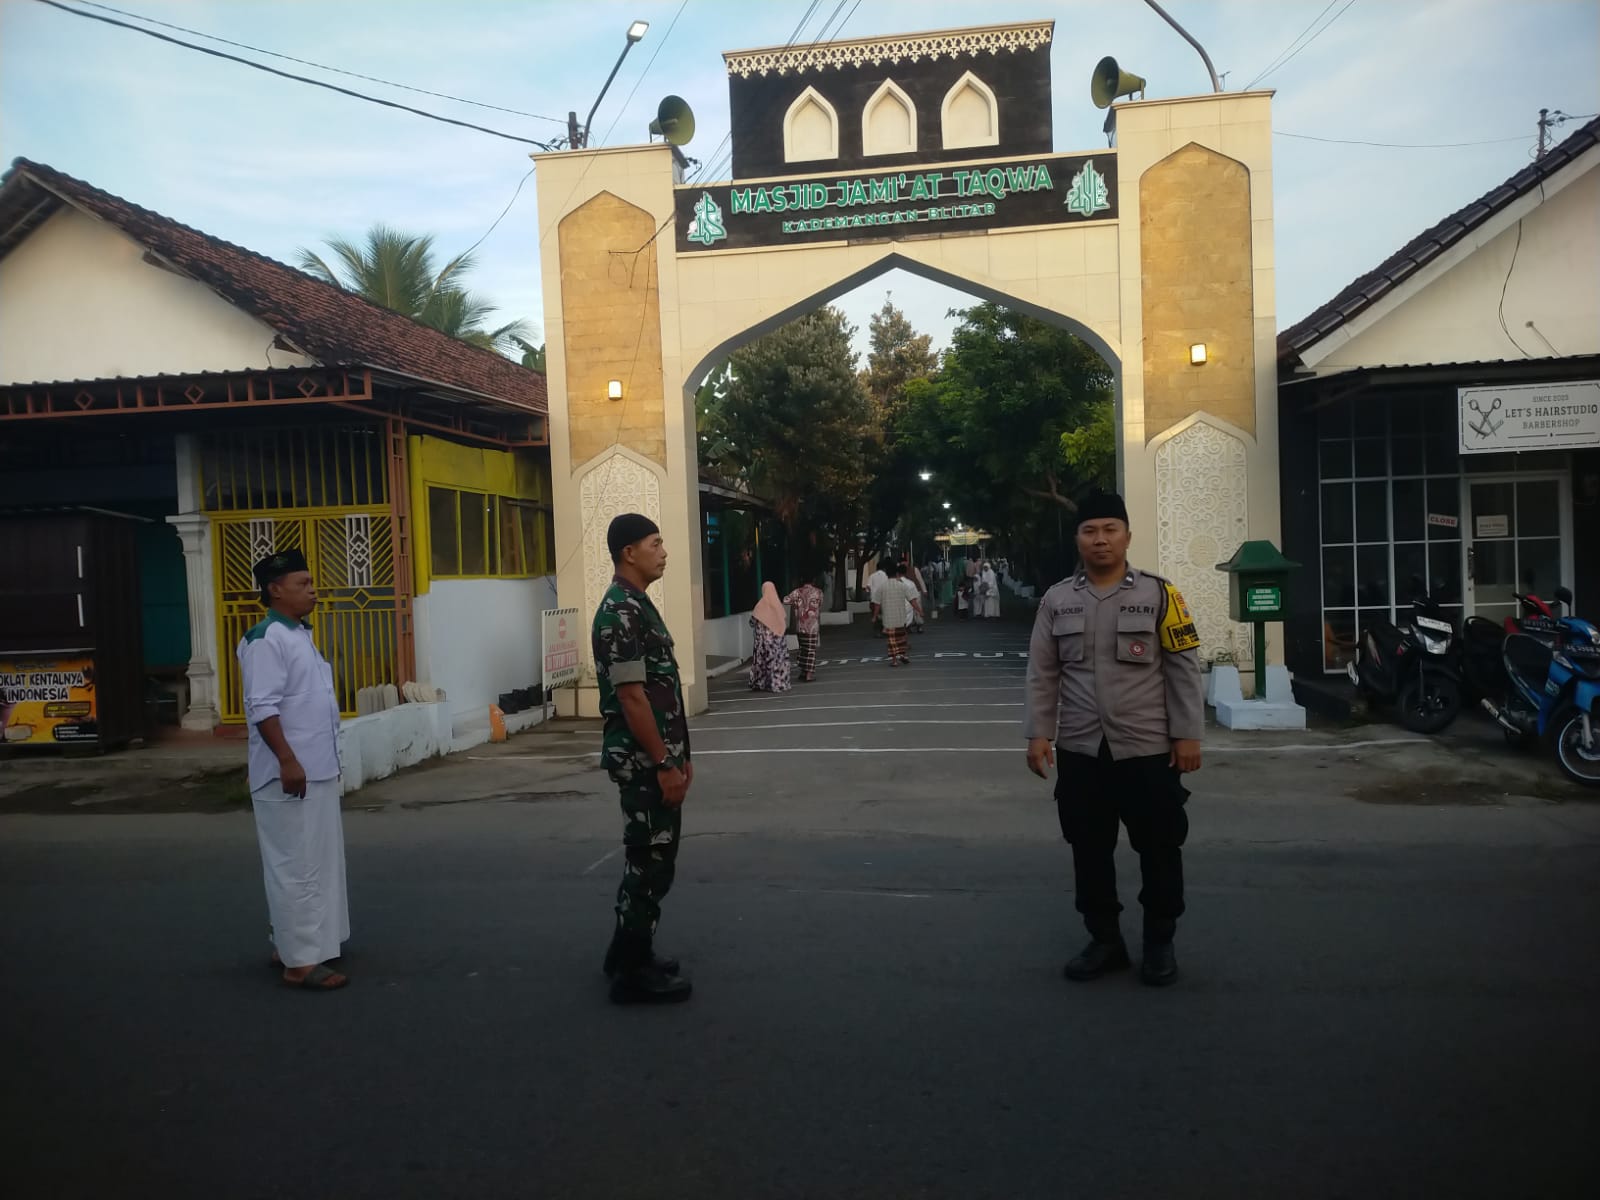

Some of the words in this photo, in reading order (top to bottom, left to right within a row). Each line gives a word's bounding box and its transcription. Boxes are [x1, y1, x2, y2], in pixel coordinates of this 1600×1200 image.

[730, 183, 829, 215] MASJID
[952, 165, 1055, 198] TAQWA
[781, 208, 920, 234] KADEMANGAN
[928, 201, 998, 221] BLITAR
[1535, 404, 1598, 418] HAIRSTUDIO
[1522, 418, 1580, 430] BARBERSHOP
[1120, 605, 1155, 615] POLRI
[30, 673, 83, 686] KENTALNYA
[8, 688, 68, 701] INDONESIA
